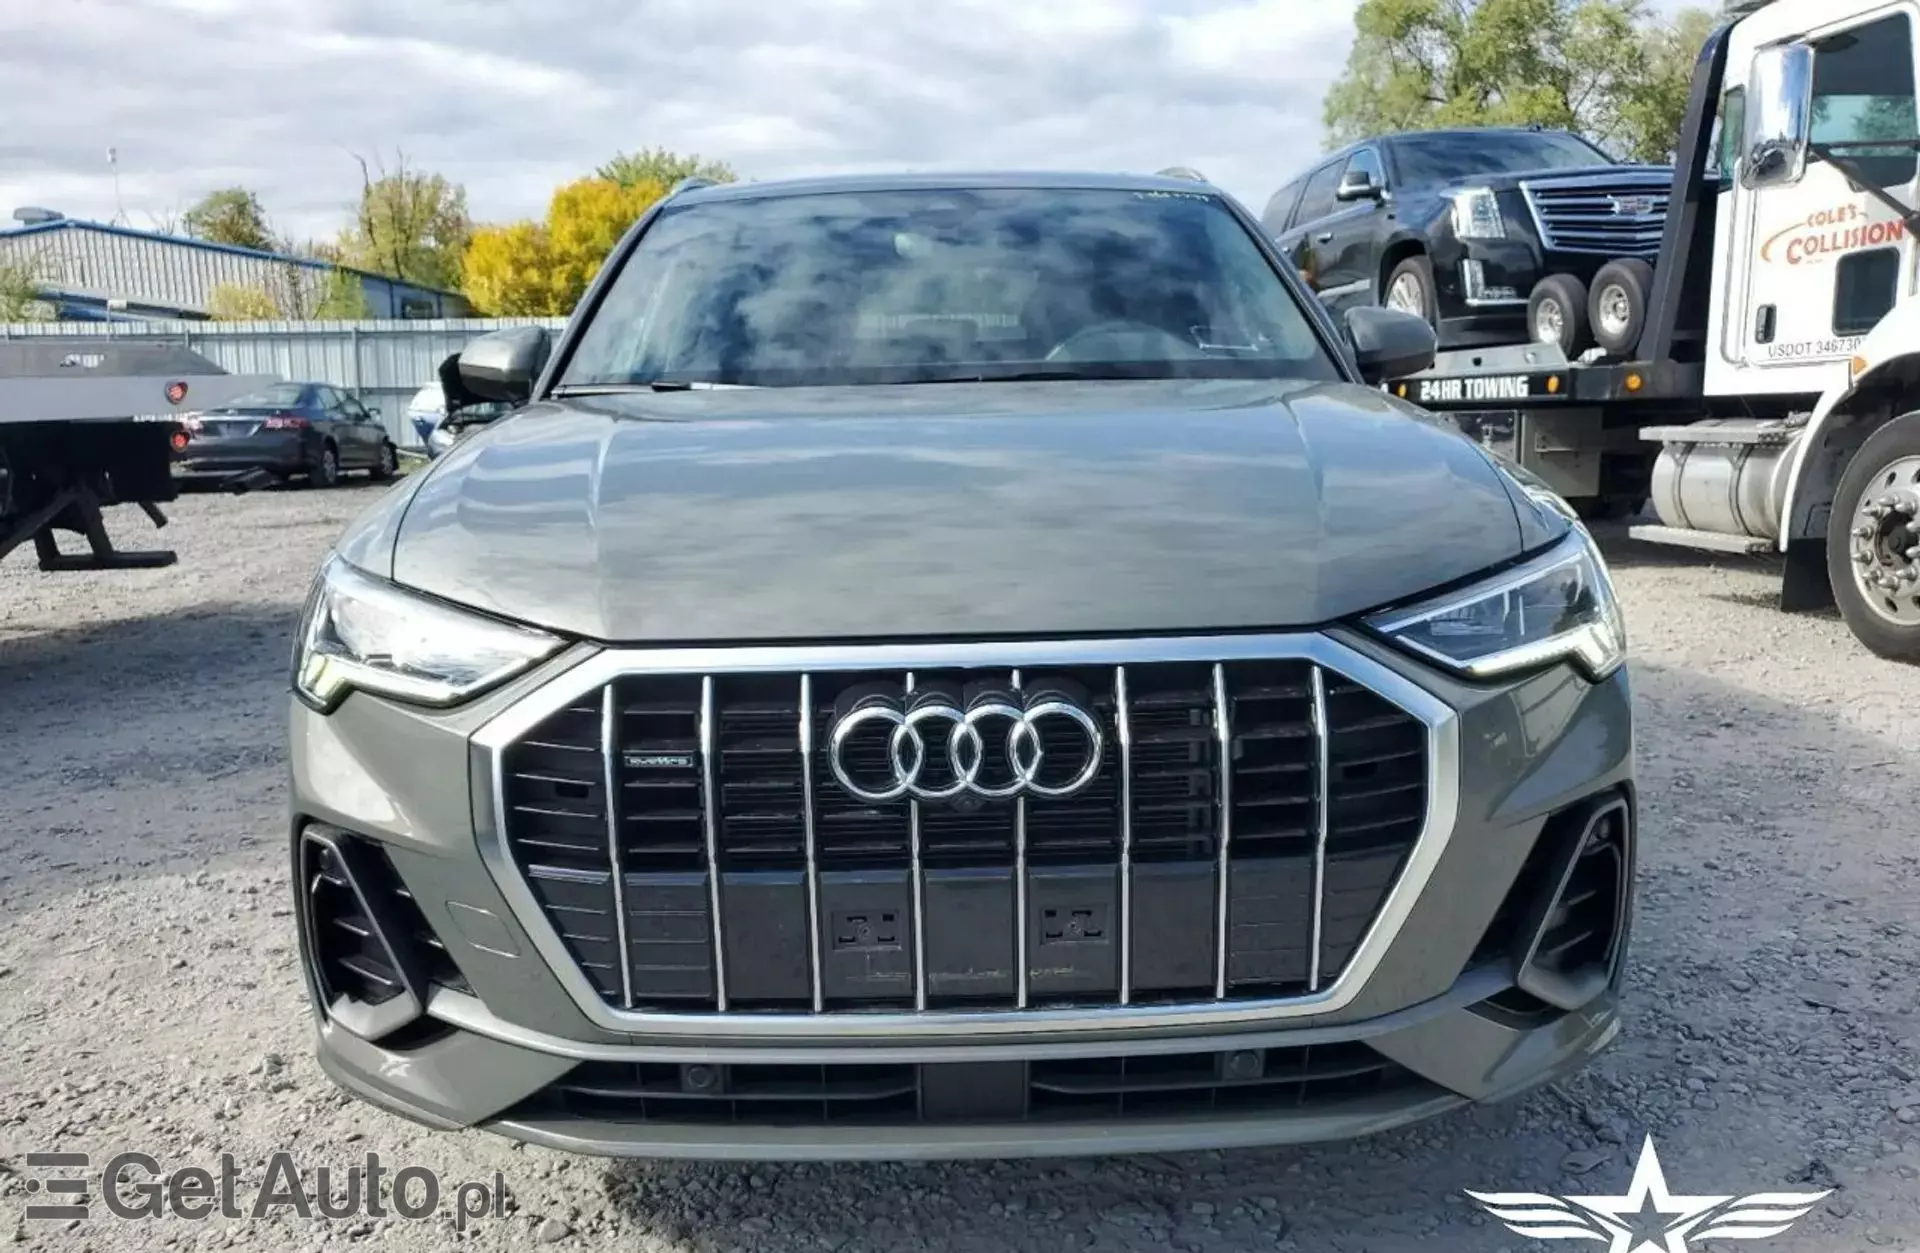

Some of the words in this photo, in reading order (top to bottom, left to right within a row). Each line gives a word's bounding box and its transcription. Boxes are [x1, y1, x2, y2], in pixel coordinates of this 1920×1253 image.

[1806, 203, 1857, 228] COLE'S
[1786, 217, 1905, 265] COLLISION
[1768, 341, 1812, 357] USDOT
[1465, 376, 1529, 398] TOWING
